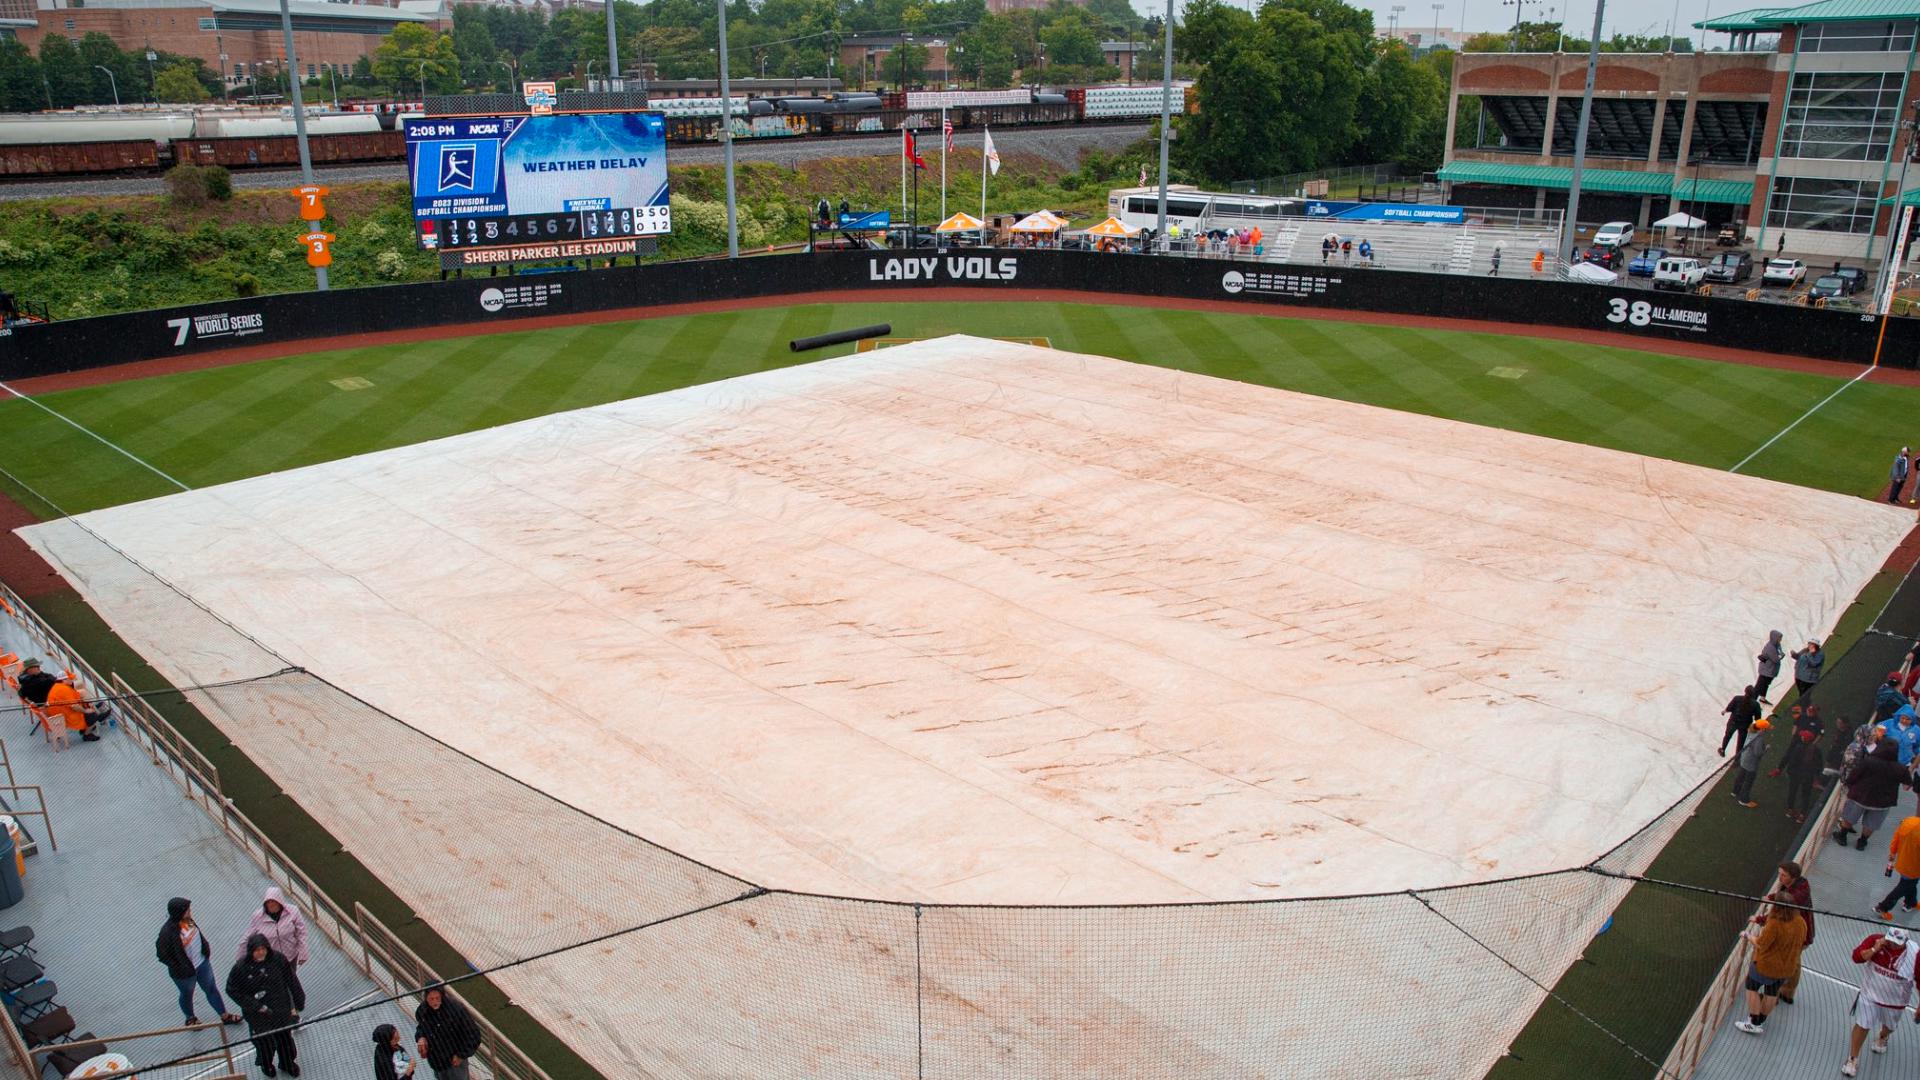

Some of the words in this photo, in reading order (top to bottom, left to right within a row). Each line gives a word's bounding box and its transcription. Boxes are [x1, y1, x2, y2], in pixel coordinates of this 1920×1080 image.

[410, 126, 436, 136] 2:08
[438, 125, 455, 135] PM
[469, 124, 499, 134] NCAA
[523, 160, 596, 173] WEATHER
[600, 157, 648, 169] DELAY
[306, 194, 316, 206] 7
[432, 199, 452, 207] 2023
[453, 198, 484, 206] DIVISION
[568, 198, 607, 206] KNOXVILLE
[417, 207, 451, 216] SOFTBALL
[453, 204, 506, 214] CHAMPIONSHIP
[636, 209, 644, 217] B
[648, 208, 656, 217] S
[1384, 208, 1412, 217] SOFTBALL
[1413, 209, 1460, 218] CHAMPIONSHIP
[591, 213, 597, 222] 1
[607, 212, 614, 221] 2
[622, 211, 630, 219] 0
[1165, 217, 1183, 225] iller
[451, 220, 458, 230] 1
[467, 220, 476, 229] 0
[485, 222, 498, 238] 3
[506, 221, 518, 236] 4
[527, 220, 538, 235] 5
[546, 219, 558, 233] 6
[566, 218, 577, 232] 7
[590, 226, 598, 235] 5
[607, 225, 615, 234] 4
[623, 224, 630, 233] 0
[661, 221, 668, 230] 2
[451, 234, 459, 244] 3
[470, 233, 478, 243] 2
[313, 241, 323, 253] 3
[464, 251, 509, 263] SHERRI
[512, 247, 559, 260] PARKER
[562, 245, 582, 256] LEE
[584, 241, 636, 255] STADIUM
[870, 257, 938, 280] LADY
[947, 257, 1017, 280] VOLS
[1606, 298, 1652, 326] 38
[1652, 307, 1707, 325] ALL-AMERICA
[195, 318, 230, 334] WORLD
[230, 313, 263, 330] SERIES
[1861, 314, 1875, 322] 200
[167, 317, 190, 346] 7
